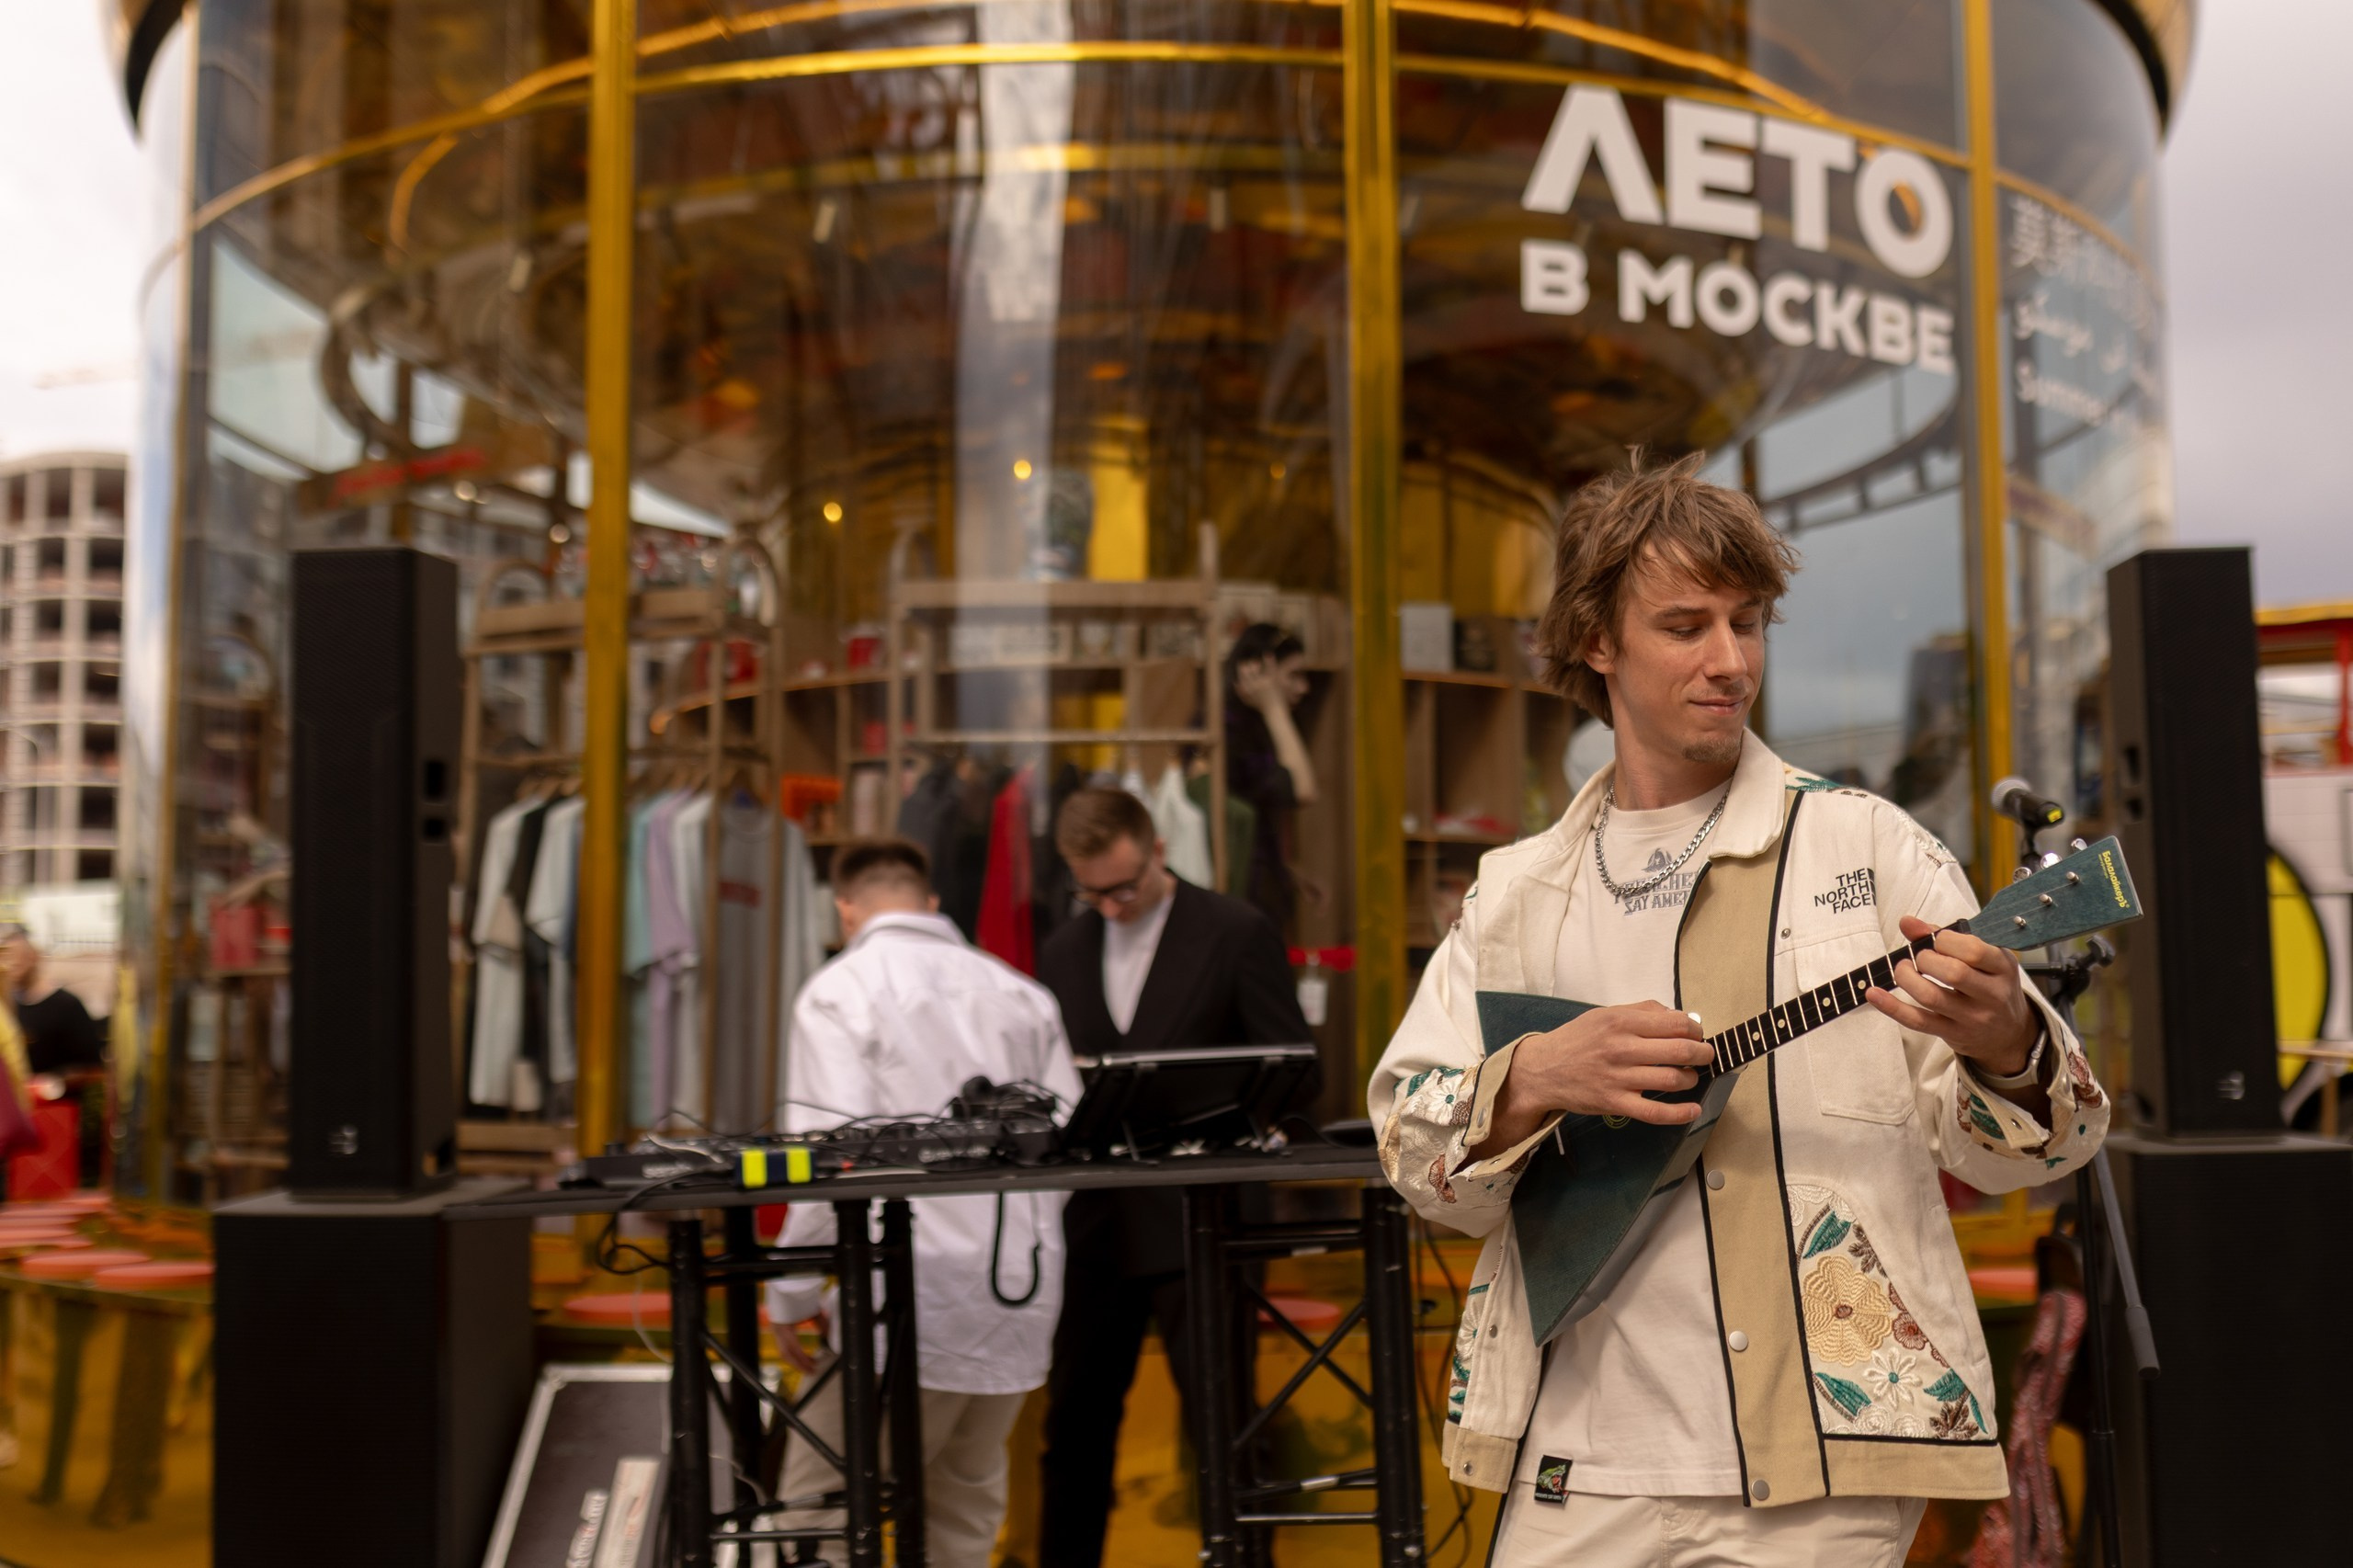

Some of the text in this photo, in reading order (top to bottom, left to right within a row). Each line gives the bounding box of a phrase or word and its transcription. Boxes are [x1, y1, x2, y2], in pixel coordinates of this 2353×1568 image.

[1520, 83, 1954, 278] ЛЕТО
[1520, 239, 1589, 315] В
[1618, 248, 1956, 376] МОСКВЕ
[1835, 868, 1868, 887] THE
[1813, 881, 1870, 907] NORTH
[1832, 892, 1871, 915] FACE
